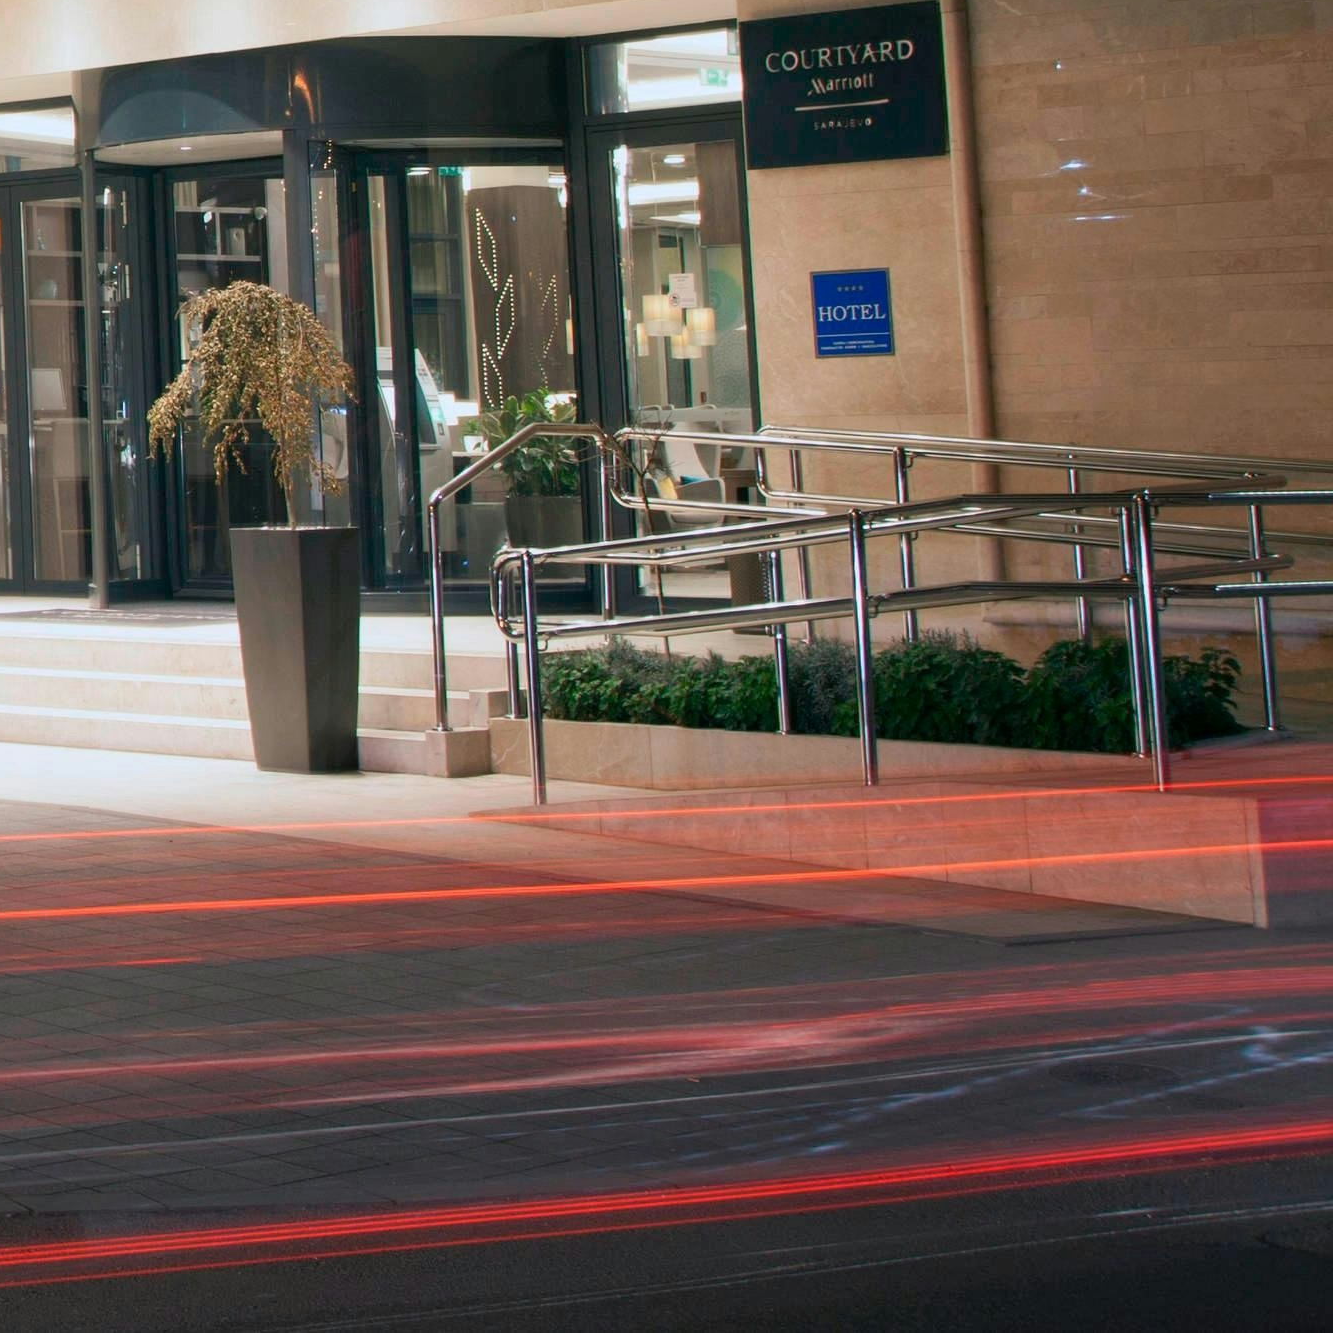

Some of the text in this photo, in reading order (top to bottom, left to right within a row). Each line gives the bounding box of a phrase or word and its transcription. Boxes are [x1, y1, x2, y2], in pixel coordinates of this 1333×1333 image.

[765, 39, 915, 73] COURTYARD
[807, 72, 875, 97] Marriott
[814, 117, 873, 131] SARAJEVO
[817, 303, 887, 323] HOTEL
